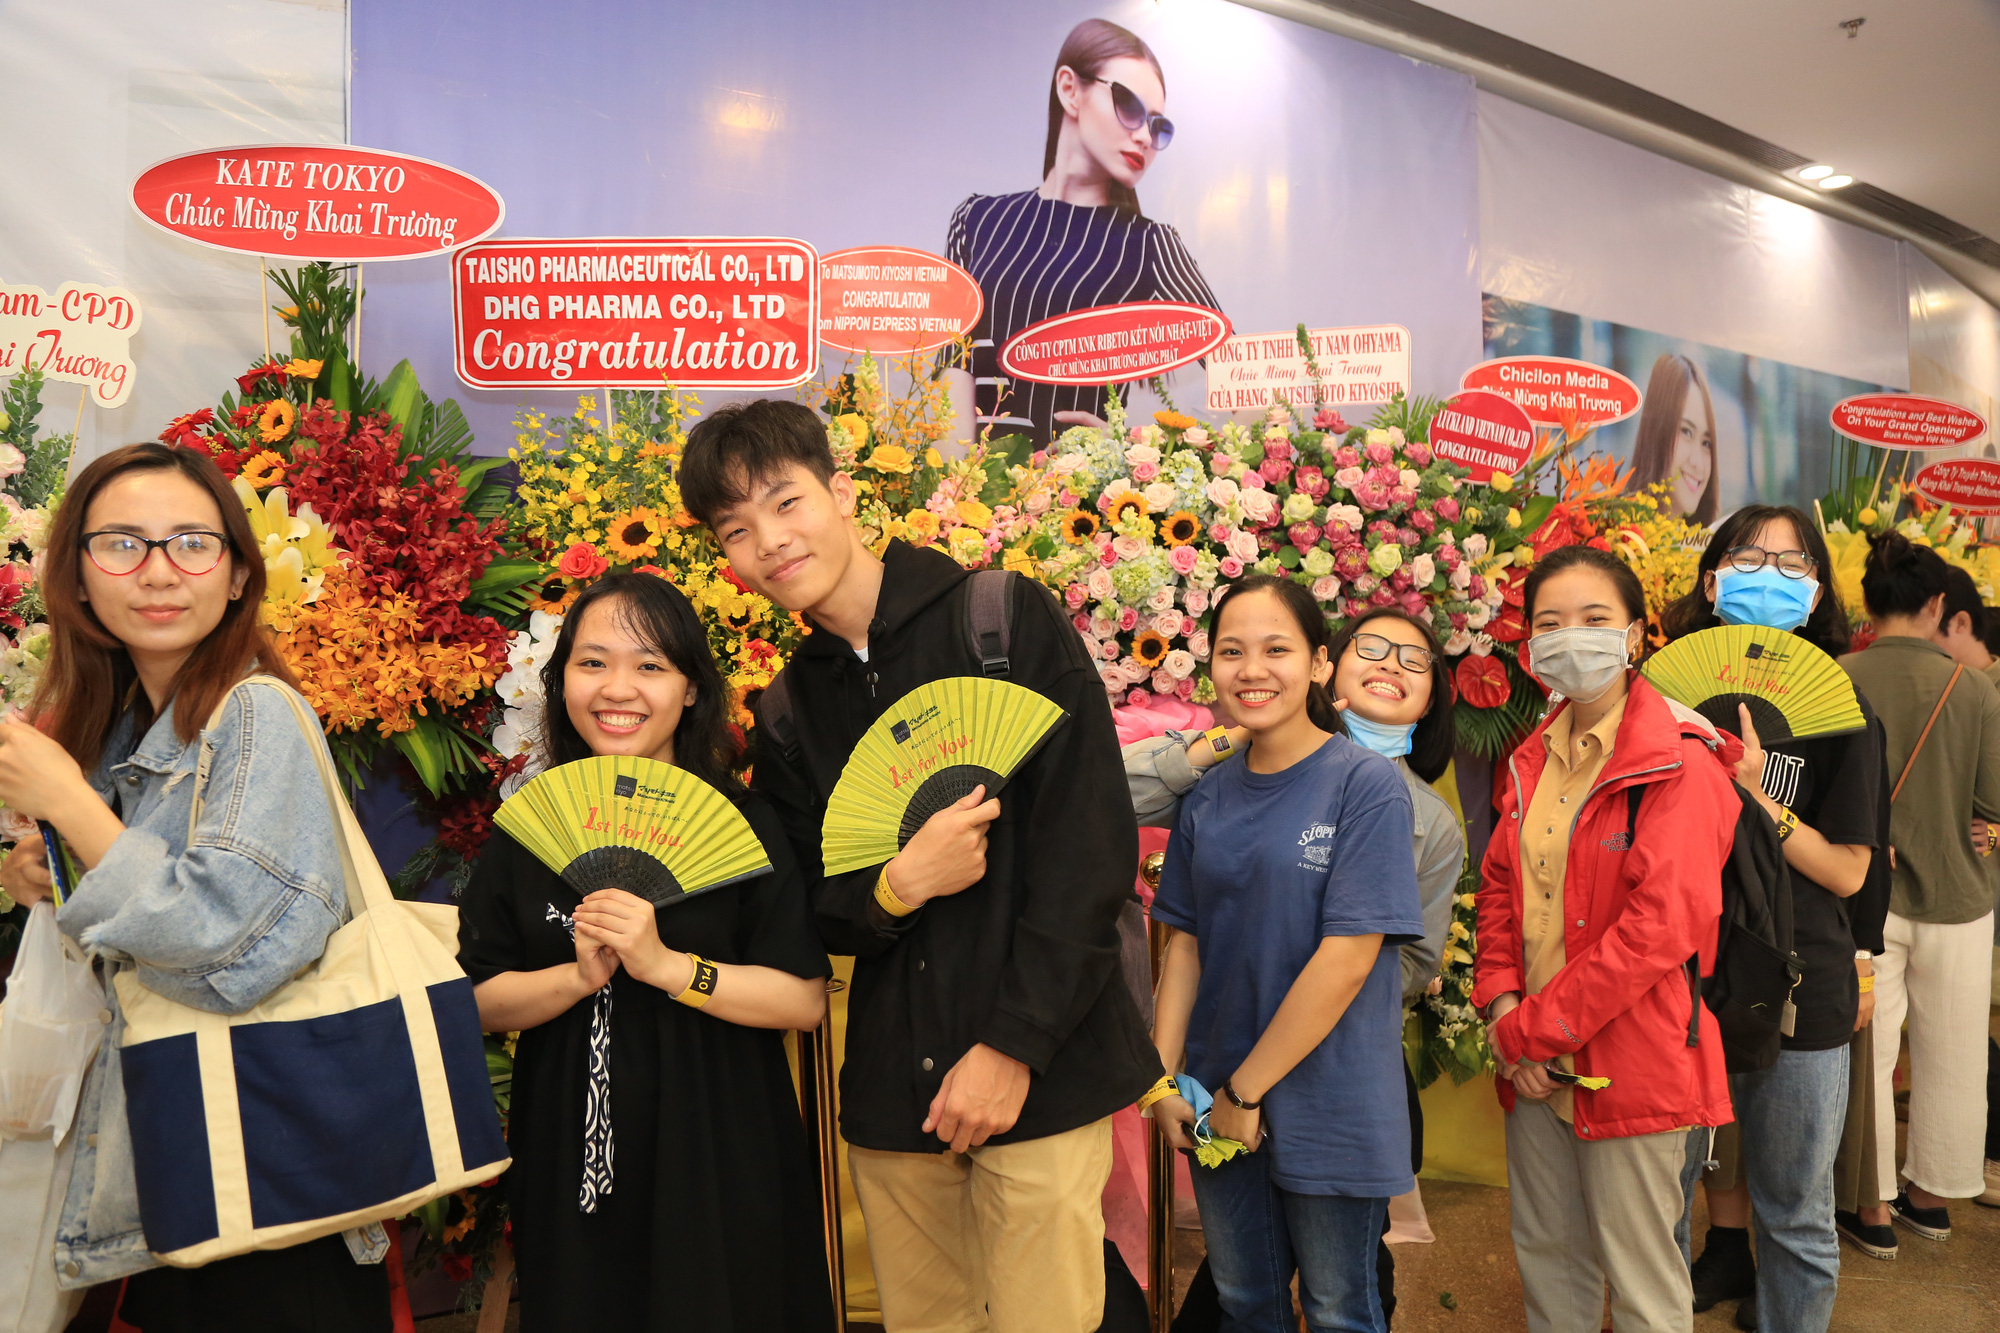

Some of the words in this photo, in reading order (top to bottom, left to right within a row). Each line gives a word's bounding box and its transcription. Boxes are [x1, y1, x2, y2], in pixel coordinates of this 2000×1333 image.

[215, 158, 294, 189] KATE
[303, 162, 405, 193] TOKYO
[165, 192, 225, 229] Chúc
[232, 196, 299, 241] Mừng
[305, 200, 363, 235] Khai
[370, 203, 458, 248] Trương
[466, 256, 534, 285] TAISHO
[540, 254, 716, 283] PHARMACEUTICAL
[721, 254, 760, 287] CO.,
[766, 254, 804, 282] LTD
[821, 264, 831, 280] To
[832, 264, 881, 281] MATSUMOTO
[881, 266, 913, 282] KIYOSHI
[914, 266, 948, 282] VIETNAM
[484, 296, 540, 320] DHG
[548, 295, 662, 320] PHARMA
[670, 294, 724, 324] CO.,
[733, 295, 785, 319] LTD
[842, 290, 930, 309] CONGRATULATION
[834, 316, 871, 331] NIPPON
[872, 317, 917, 332] EXPRESS
[919, 318, 961, 333] VIETNAM
[473, 327, 799, 380] Congratulation
[1015, 339, 1040, 362] CÔNG
[1041, 341, 1052, 358] TY
[1053, 338, 1077, 357] CPTM
[1078, 335, 1096, 354] XNK
[1097, 331, 1129, 352] RIBETO
[1246, 341, 1259, 360] TY
[1262, 338, 1294, 360] TNHH
[1326, 334, 1350, 356] NAM
[1353, 331, 1402, 354] OHYAMA
[1048, 359, 1068, 377] CHÚC
[1090, 357, 1108, 373] KHAI
[1499, 365, 1561, 385] Chicilon
[1565, 371, 1609, 390] Media
[1236, 382, 1268, 407] HÀNG
[1514, 388, 1548, 411] Mừng
[1550, 392, 1577, 409] Khai
[1436, 409, 1475, 436] LUCKLAND
[1474, 418, 1506, 443] VIETNAM
[1841, 402, 1907, 419] Congratulations
[1908, 411, 1925, 421] and
[1926, 412, 1945, 424] Best
[1946, 415, 1977, 427] Wishes
[1847, 415, 1861, 425] On
[1863, 416, 1886, 428] Your
[1888, 418, 1918, 431] Grand
[1920, 422, 1967, 438] Opening!
[1883, 430, 1902, 440] Black
[1902, 431, 1925, 443] Rouge
[1434, 439, 1519, 472] CONGRATULATIONS
[1715, 665, 1739, 686] 1st
[1742, 677, 1762, 690] for
[1764, 679, 1790, 695] You.
[888, 765, 915, 789] 1st
[918, 753, 937, 774] for
[937, 734, 974, 759] You.
[583, 806, 612, 834] 1st
[617, 820, 643, 841] for
[647, 825, 684, 849] You.
[1297, 825, 1337, 846] SLOPP
[1610, 832, 1625, 840] THE
[1600, 838, 1626, 847] NORTH
[1607, 844, 1626, 853] FACE
[698, 967, 712, 991] 014
